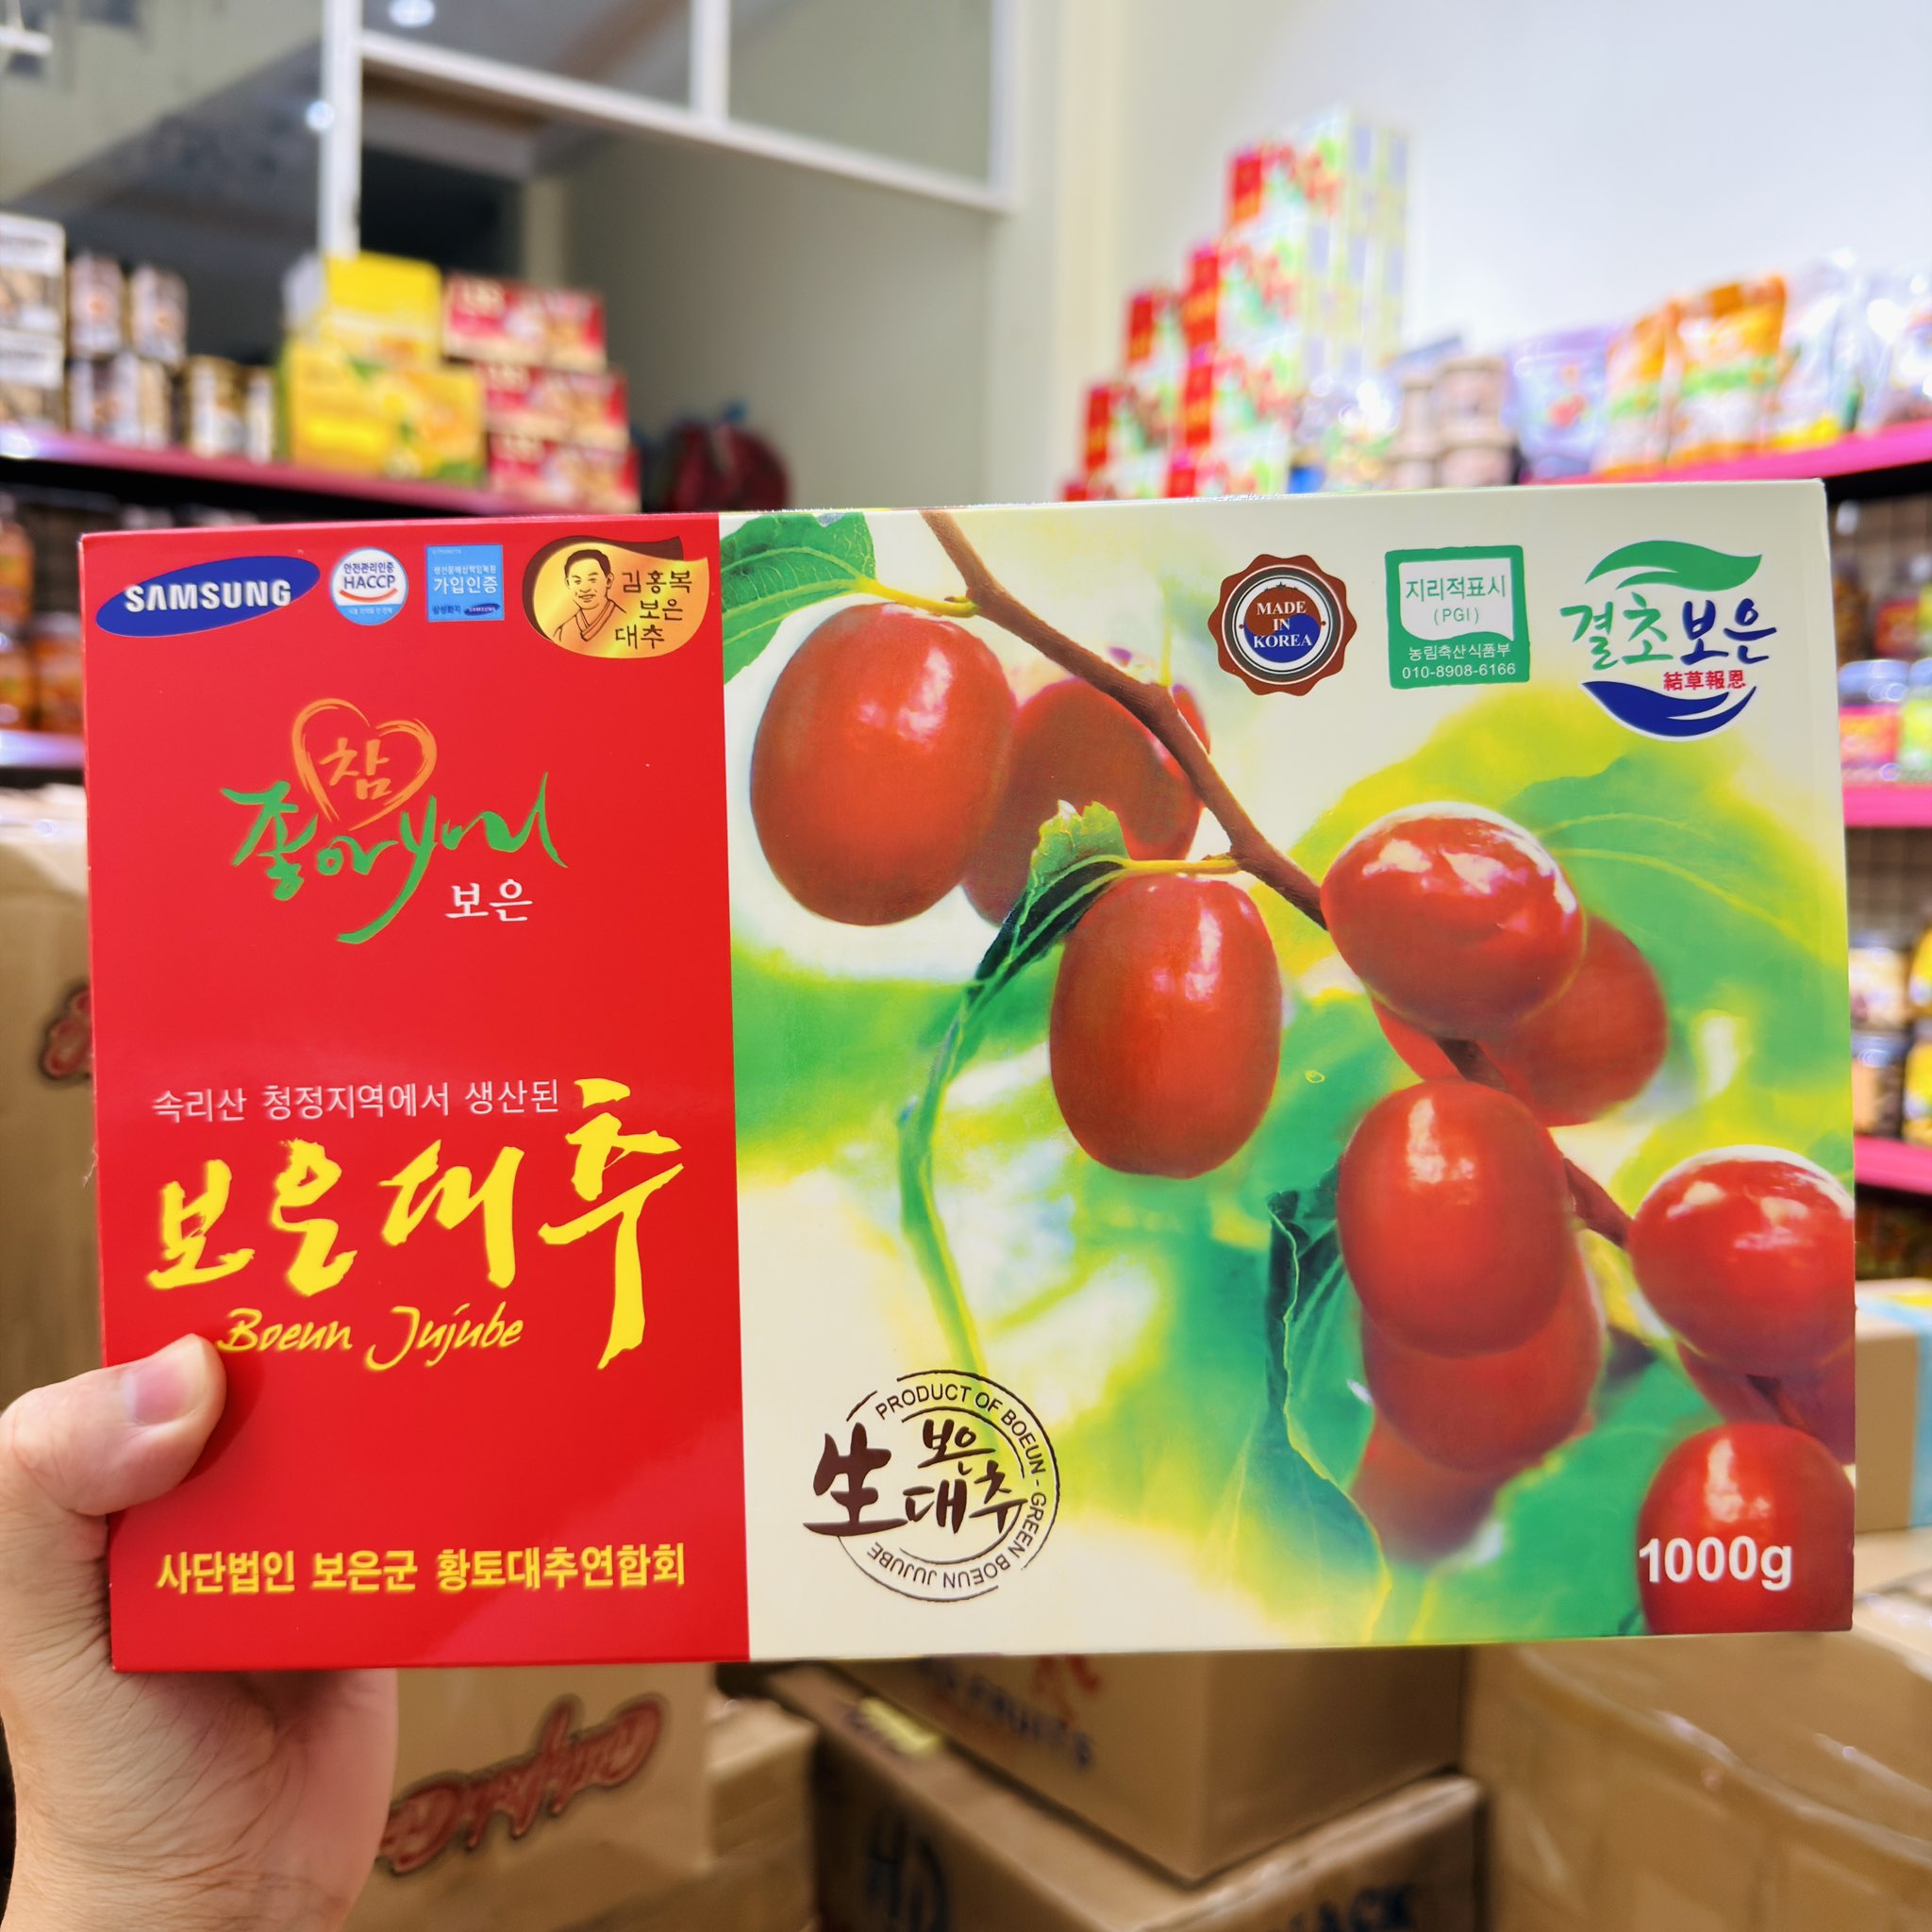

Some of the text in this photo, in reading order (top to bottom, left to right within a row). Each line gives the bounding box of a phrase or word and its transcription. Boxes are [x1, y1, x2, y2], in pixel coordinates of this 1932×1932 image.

[343, 561, 394, 575] 안전관리인증
[343, 575, 395, 589] HACCP
[622, 570, 692, 593] 김홍복
[125, 576, 292, 614] SAMSUNG
[433, 576, 499, 595] 가입인증
[1405, 575, 1507, 603] 지리적표시
[640, 598, 683, 622] 보은
[1256, 601, 1307, 615] MADE
[615, 625, 664, 649] 대추
[1273, 618, 1291, 632] IN
[1253, 633, 1313, 649] KOREA
[1408, 642, 1511, 661] 농림축산식품부
[1401, 662, 1517, 679] 010-8908-6166
[1663, 669, 1746, 691] 結草報恩
[320, 737, 392, 800] 참
[445, 878, 534, 922] 보은
[151, 1078, 559, 1123] 속리산 청정지역에서 생산된
[216, 1302, 524, 1372] Boeun Jujube
[874, 1383, 972, 1420] PRODUCT
[974, 1391, 1003, 1412] OF
[1000, 1408, 1046, 1474] BOEUN
[803, 1422, 908, 1537] 生
[903, 1459, 1029, 1535] 대추
[1007, 1492, 1047, 1555] GREEN
[156, 1541, 686, 1594] 사단법인 보은군 황토대추연합회
[866, 1541, 938, 1586] JUJUBE
[943, 1554, 1011, 1589] BOEUN
[1639, 1535, 1792, 1591] 1000g
